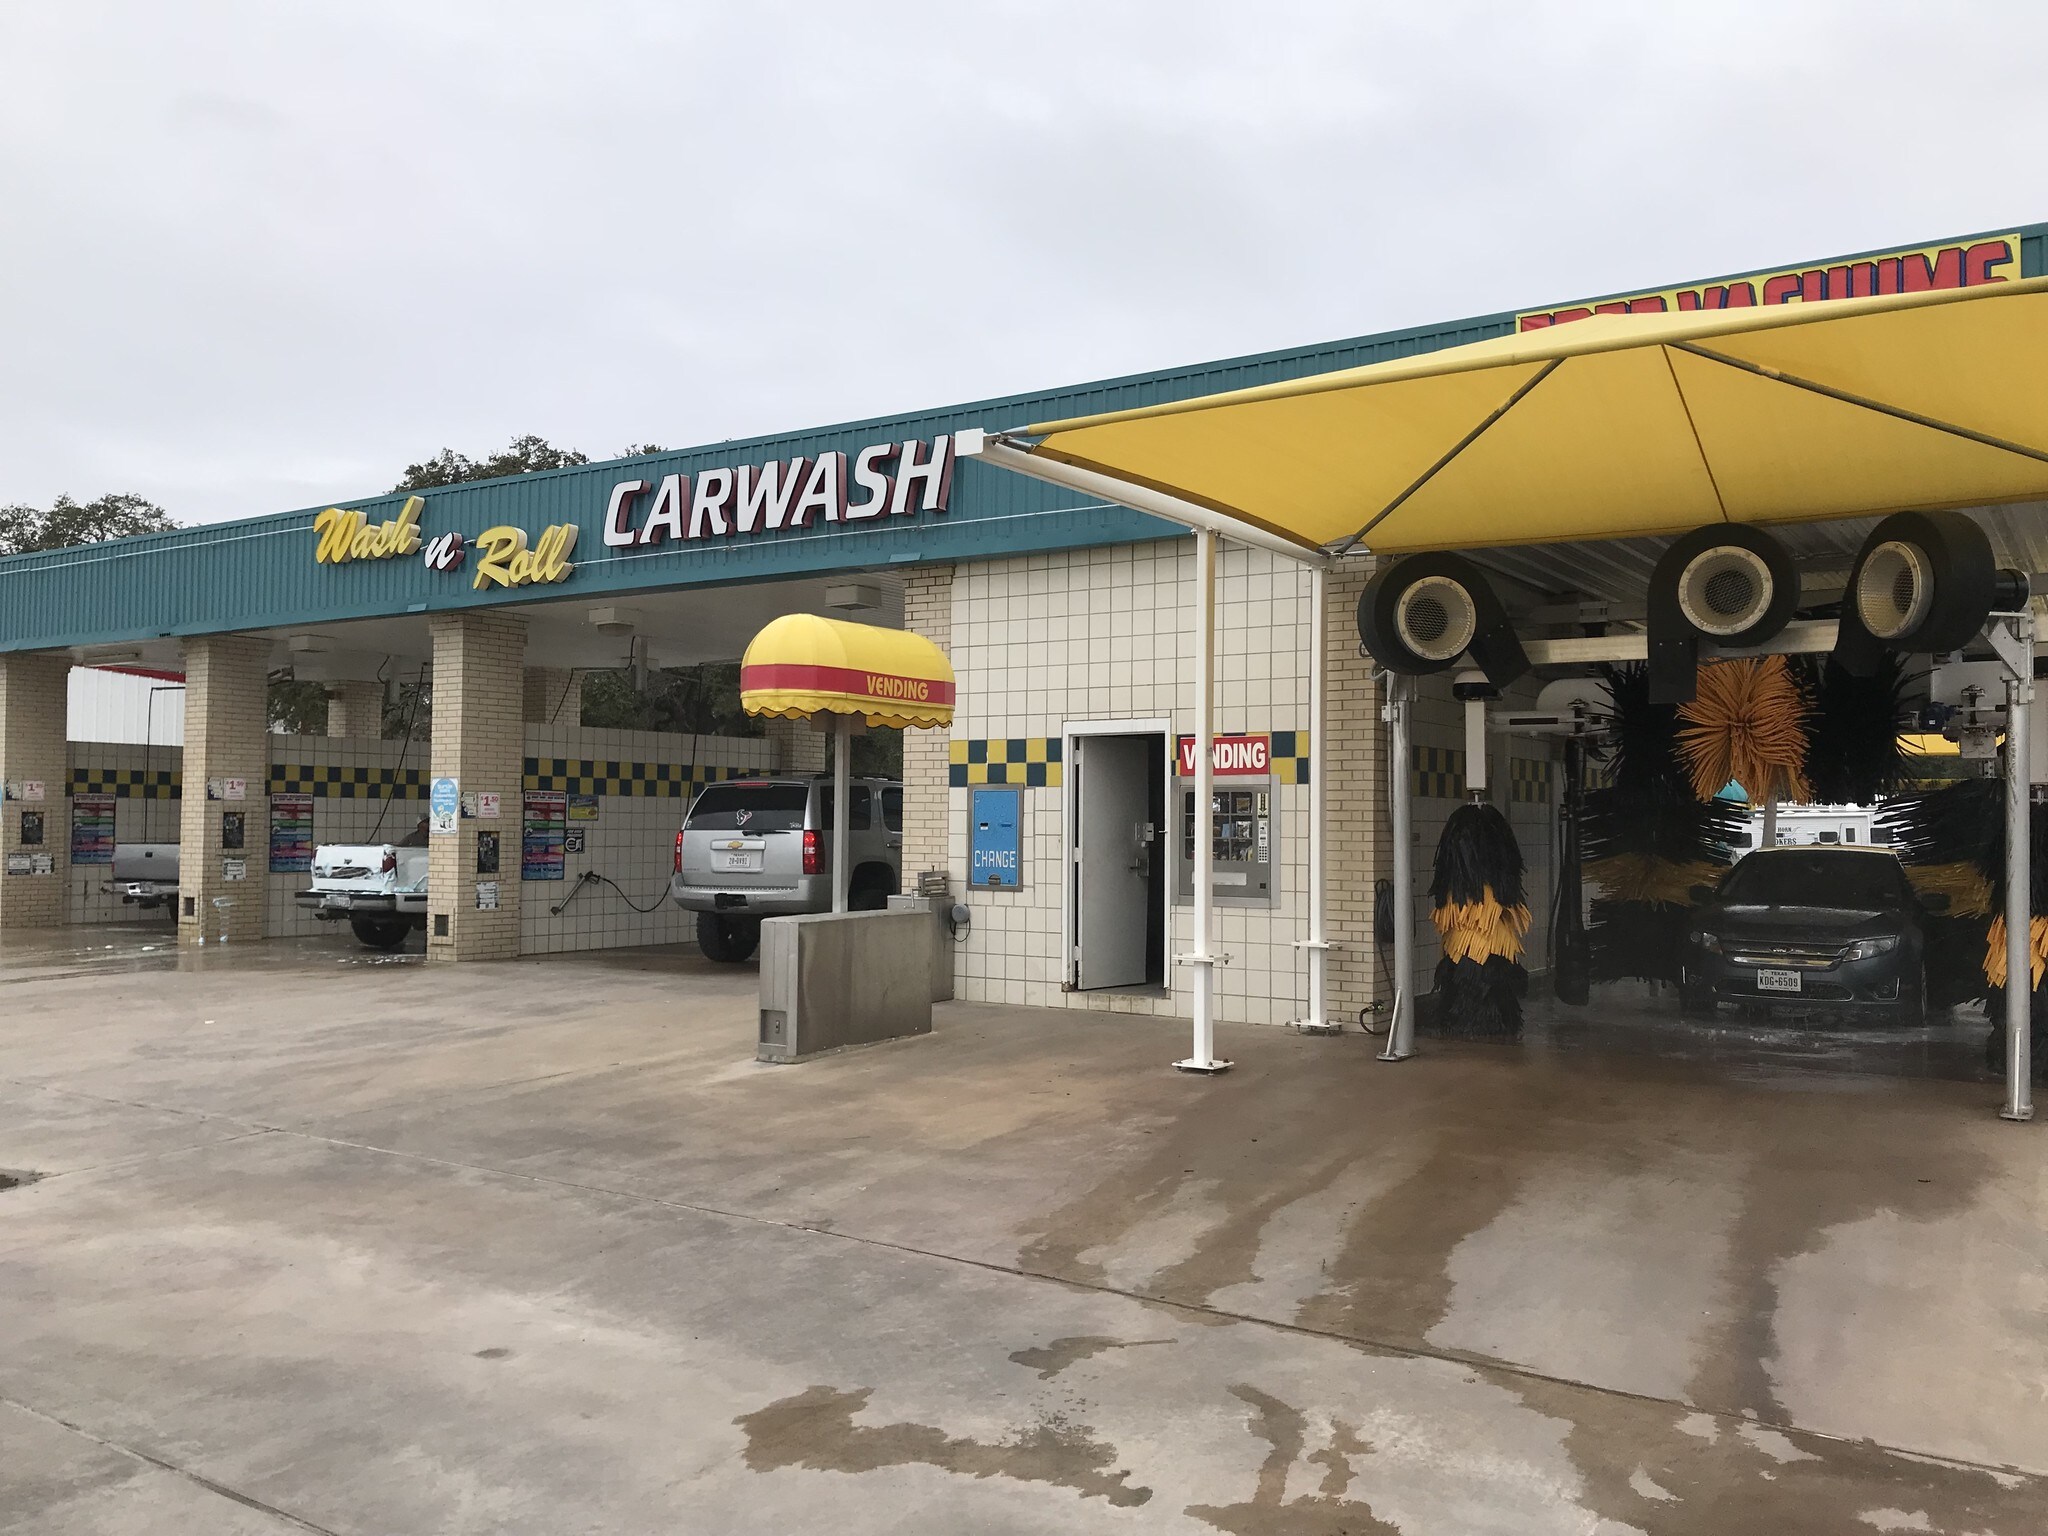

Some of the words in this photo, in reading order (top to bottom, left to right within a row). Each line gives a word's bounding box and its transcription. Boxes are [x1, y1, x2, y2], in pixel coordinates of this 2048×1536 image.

[603, 435, 955, 548] CARWASH
[314, 496, 424, 564] Wash
[424, 531, 461, 570] n
[473, 523, 578, 589] Roll
[867, 675, 929, 700] VENDING
[1183, 742, 1266, 770] VNDING
[974, 850, 1016, 869] CHANGE
